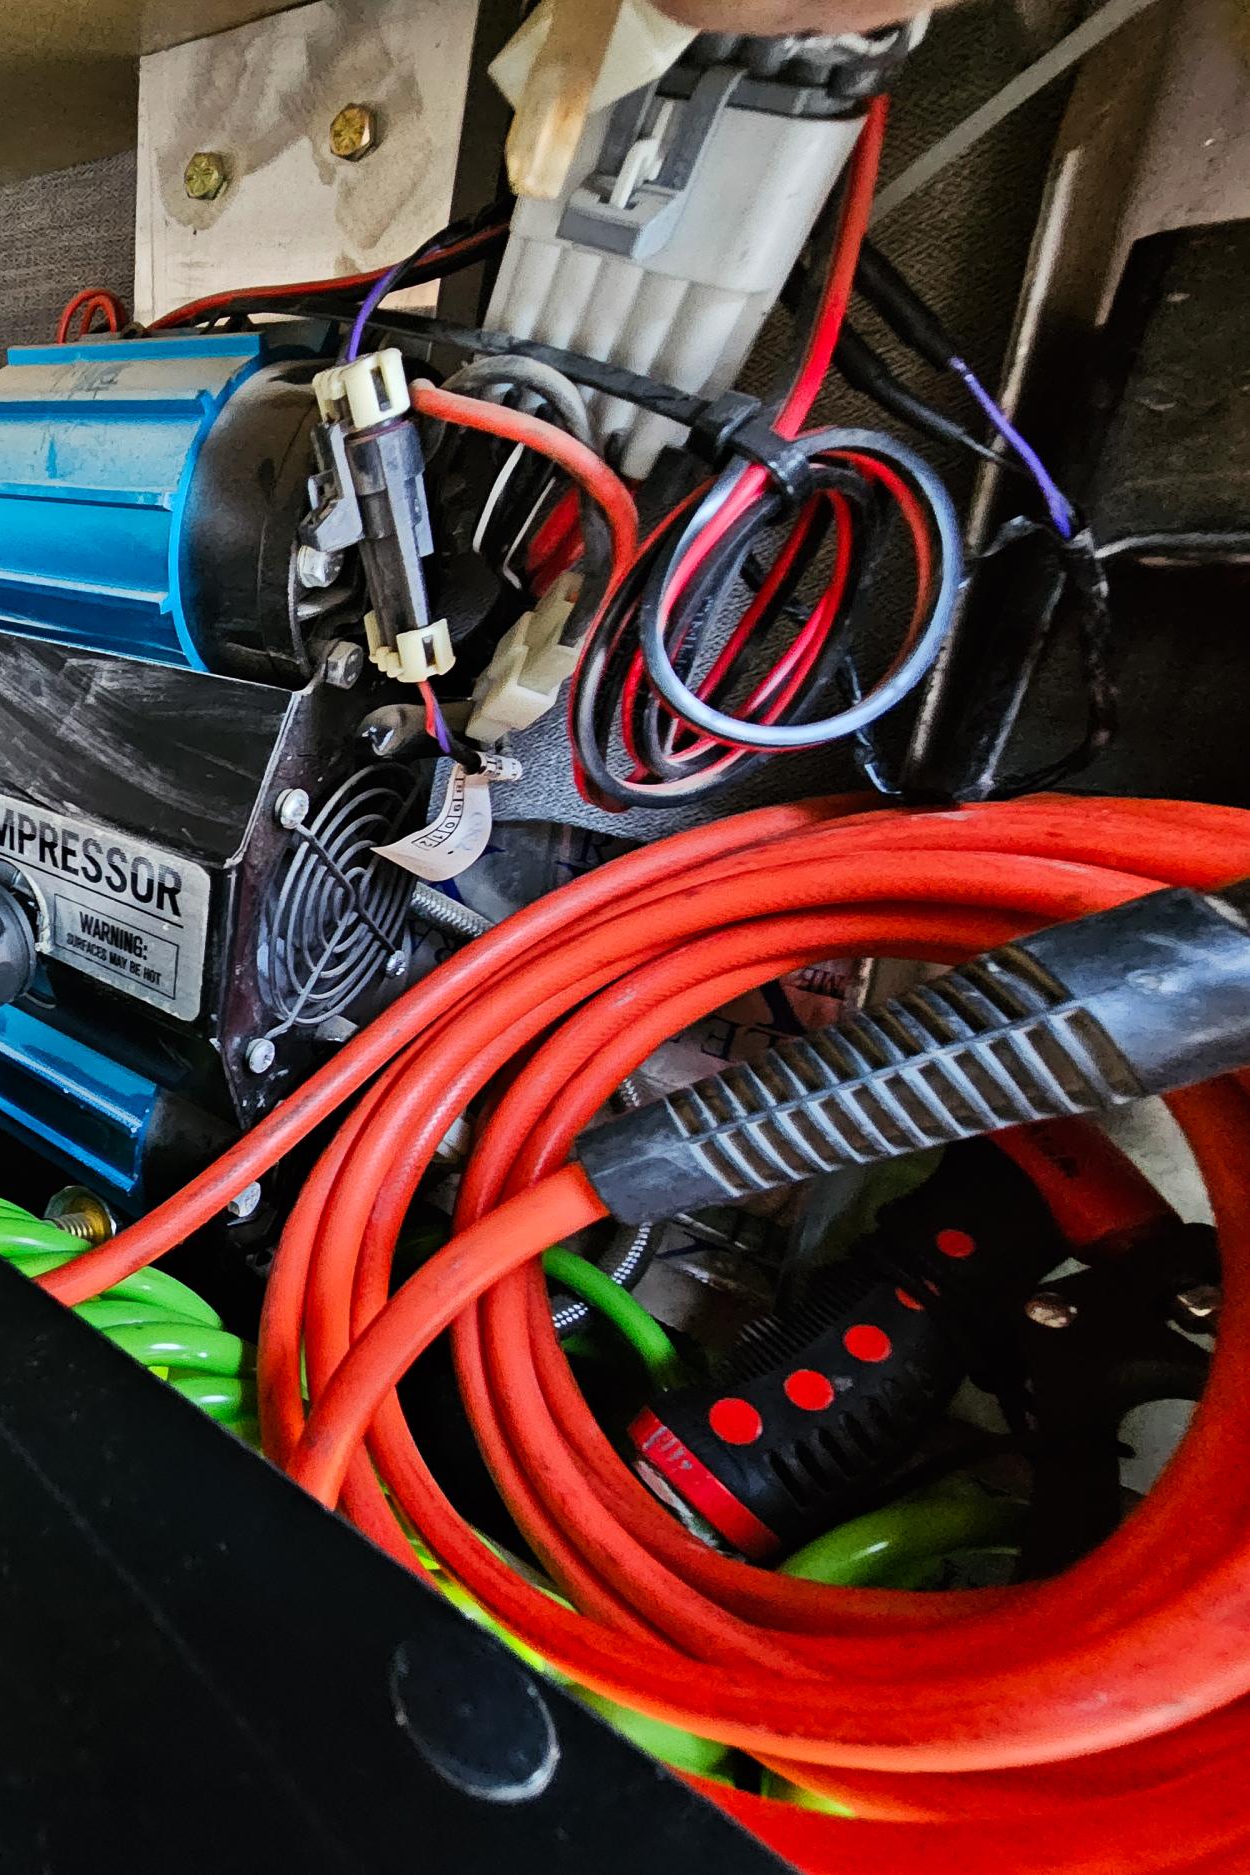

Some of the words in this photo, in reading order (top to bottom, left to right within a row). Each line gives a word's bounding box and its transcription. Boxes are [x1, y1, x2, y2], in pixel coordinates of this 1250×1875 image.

[66, 932, 107, 962] SURFACES
[108, 951, 128, 970] MAY
[129, 960, 141, 977] BE
[143, 967, 162, 986] HOT
[79, 911, 148, 961] WARNING:
